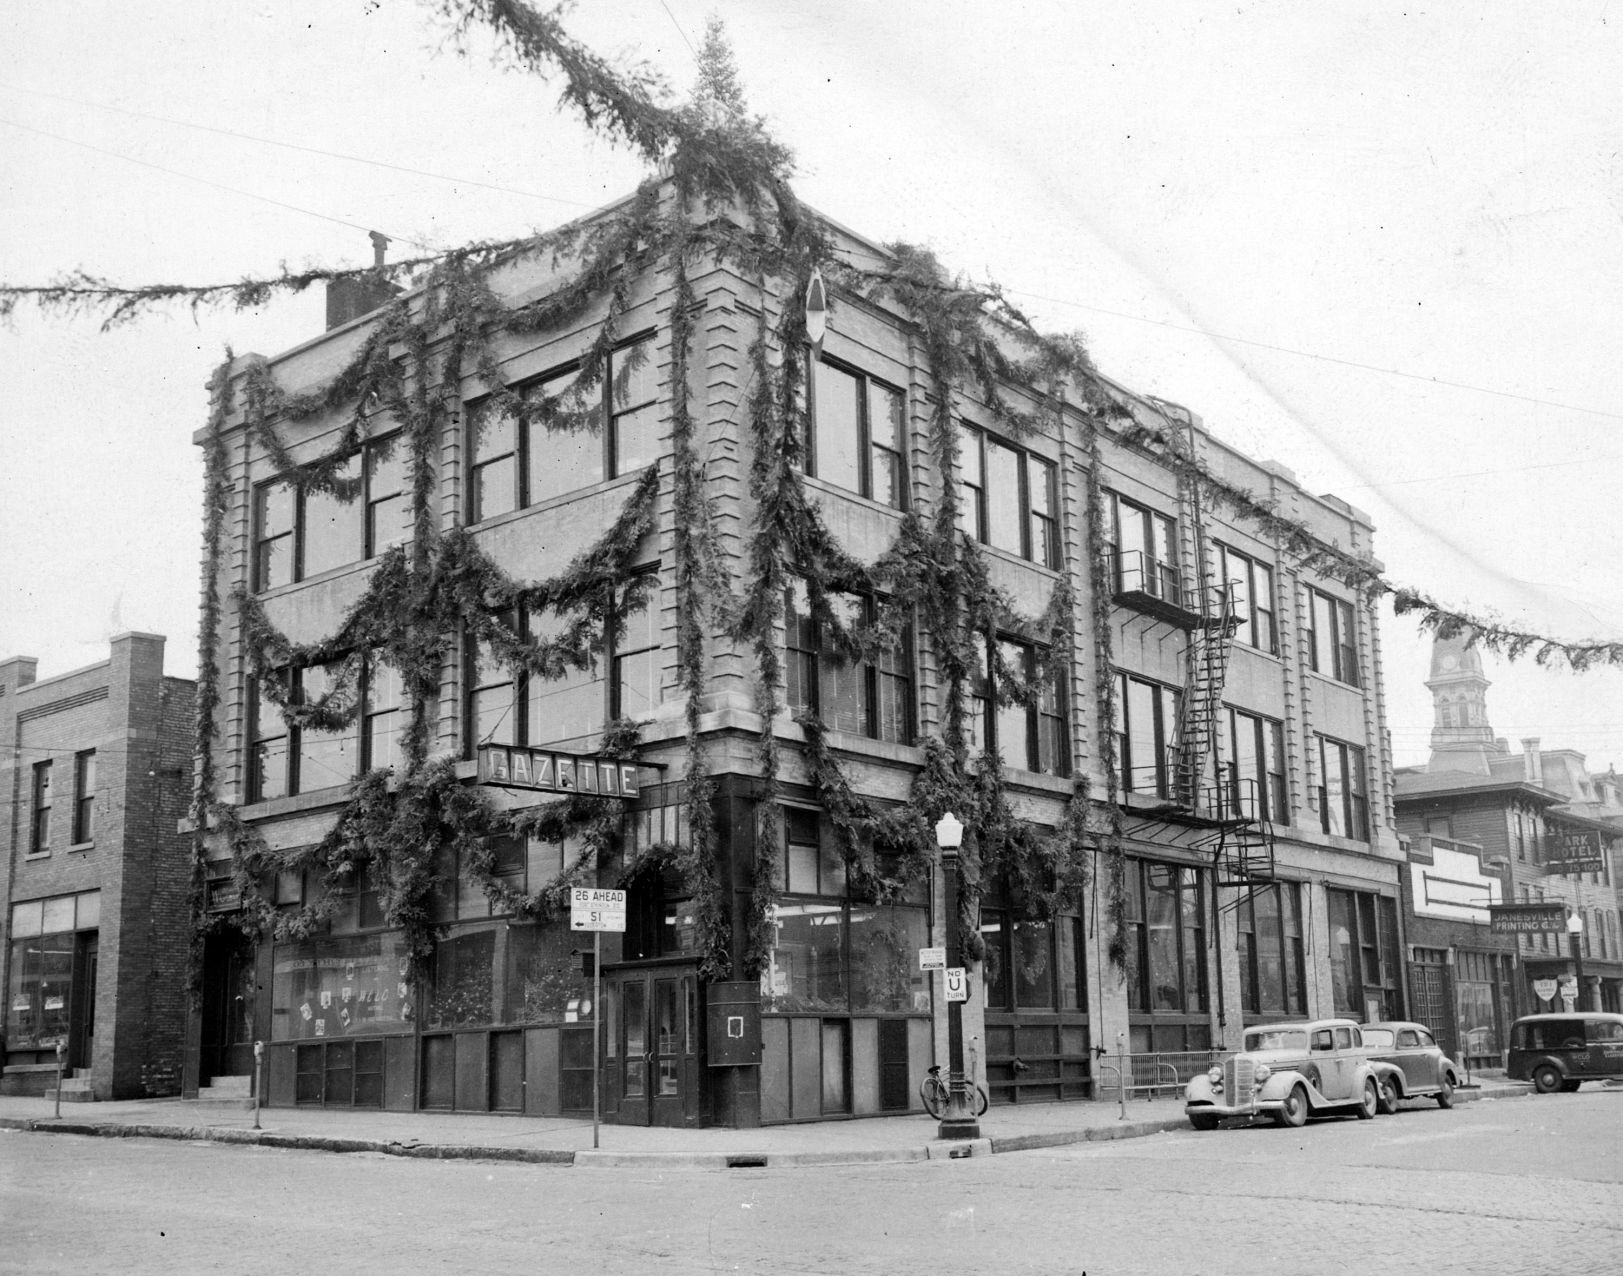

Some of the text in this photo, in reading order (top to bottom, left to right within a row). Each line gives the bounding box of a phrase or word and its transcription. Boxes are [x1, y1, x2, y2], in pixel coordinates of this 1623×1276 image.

[489, 750, 637, 794] GAZETTE
[575, 890, 623, 902] 26 AHEAD
[1494, 911, 1561, 921] JANESVILLE
[1496, 920, 1539, 931] PRINTING
[949, 978, 960, 991] U
